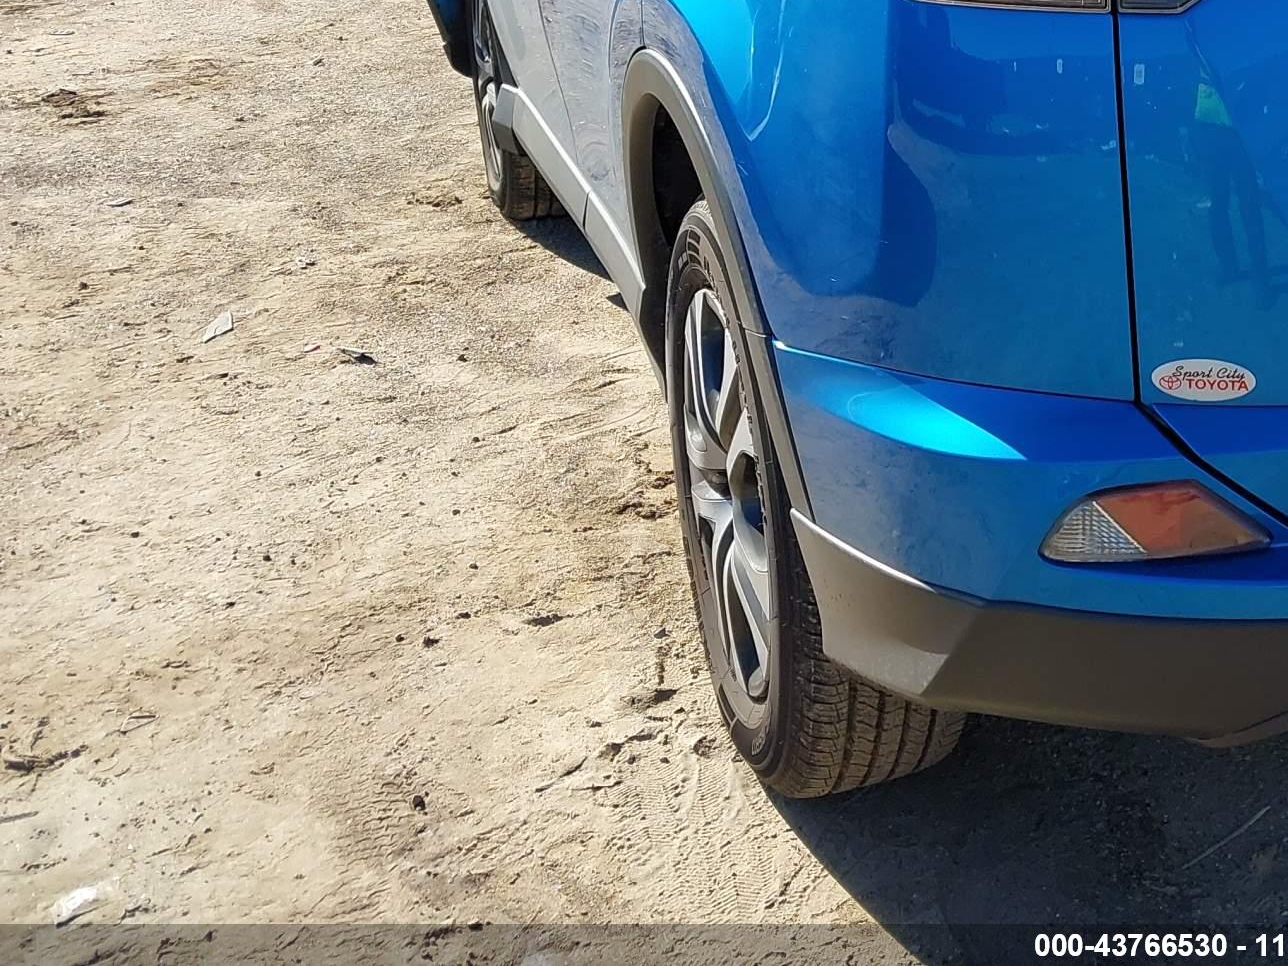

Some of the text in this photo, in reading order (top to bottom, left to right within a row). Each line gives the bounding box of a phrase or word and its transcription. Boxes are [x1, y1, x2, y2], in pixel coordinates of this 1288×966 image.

[1172, 365, 1246, 382] Sport City
[1186, 378, 1248, 391] TOYOTA
